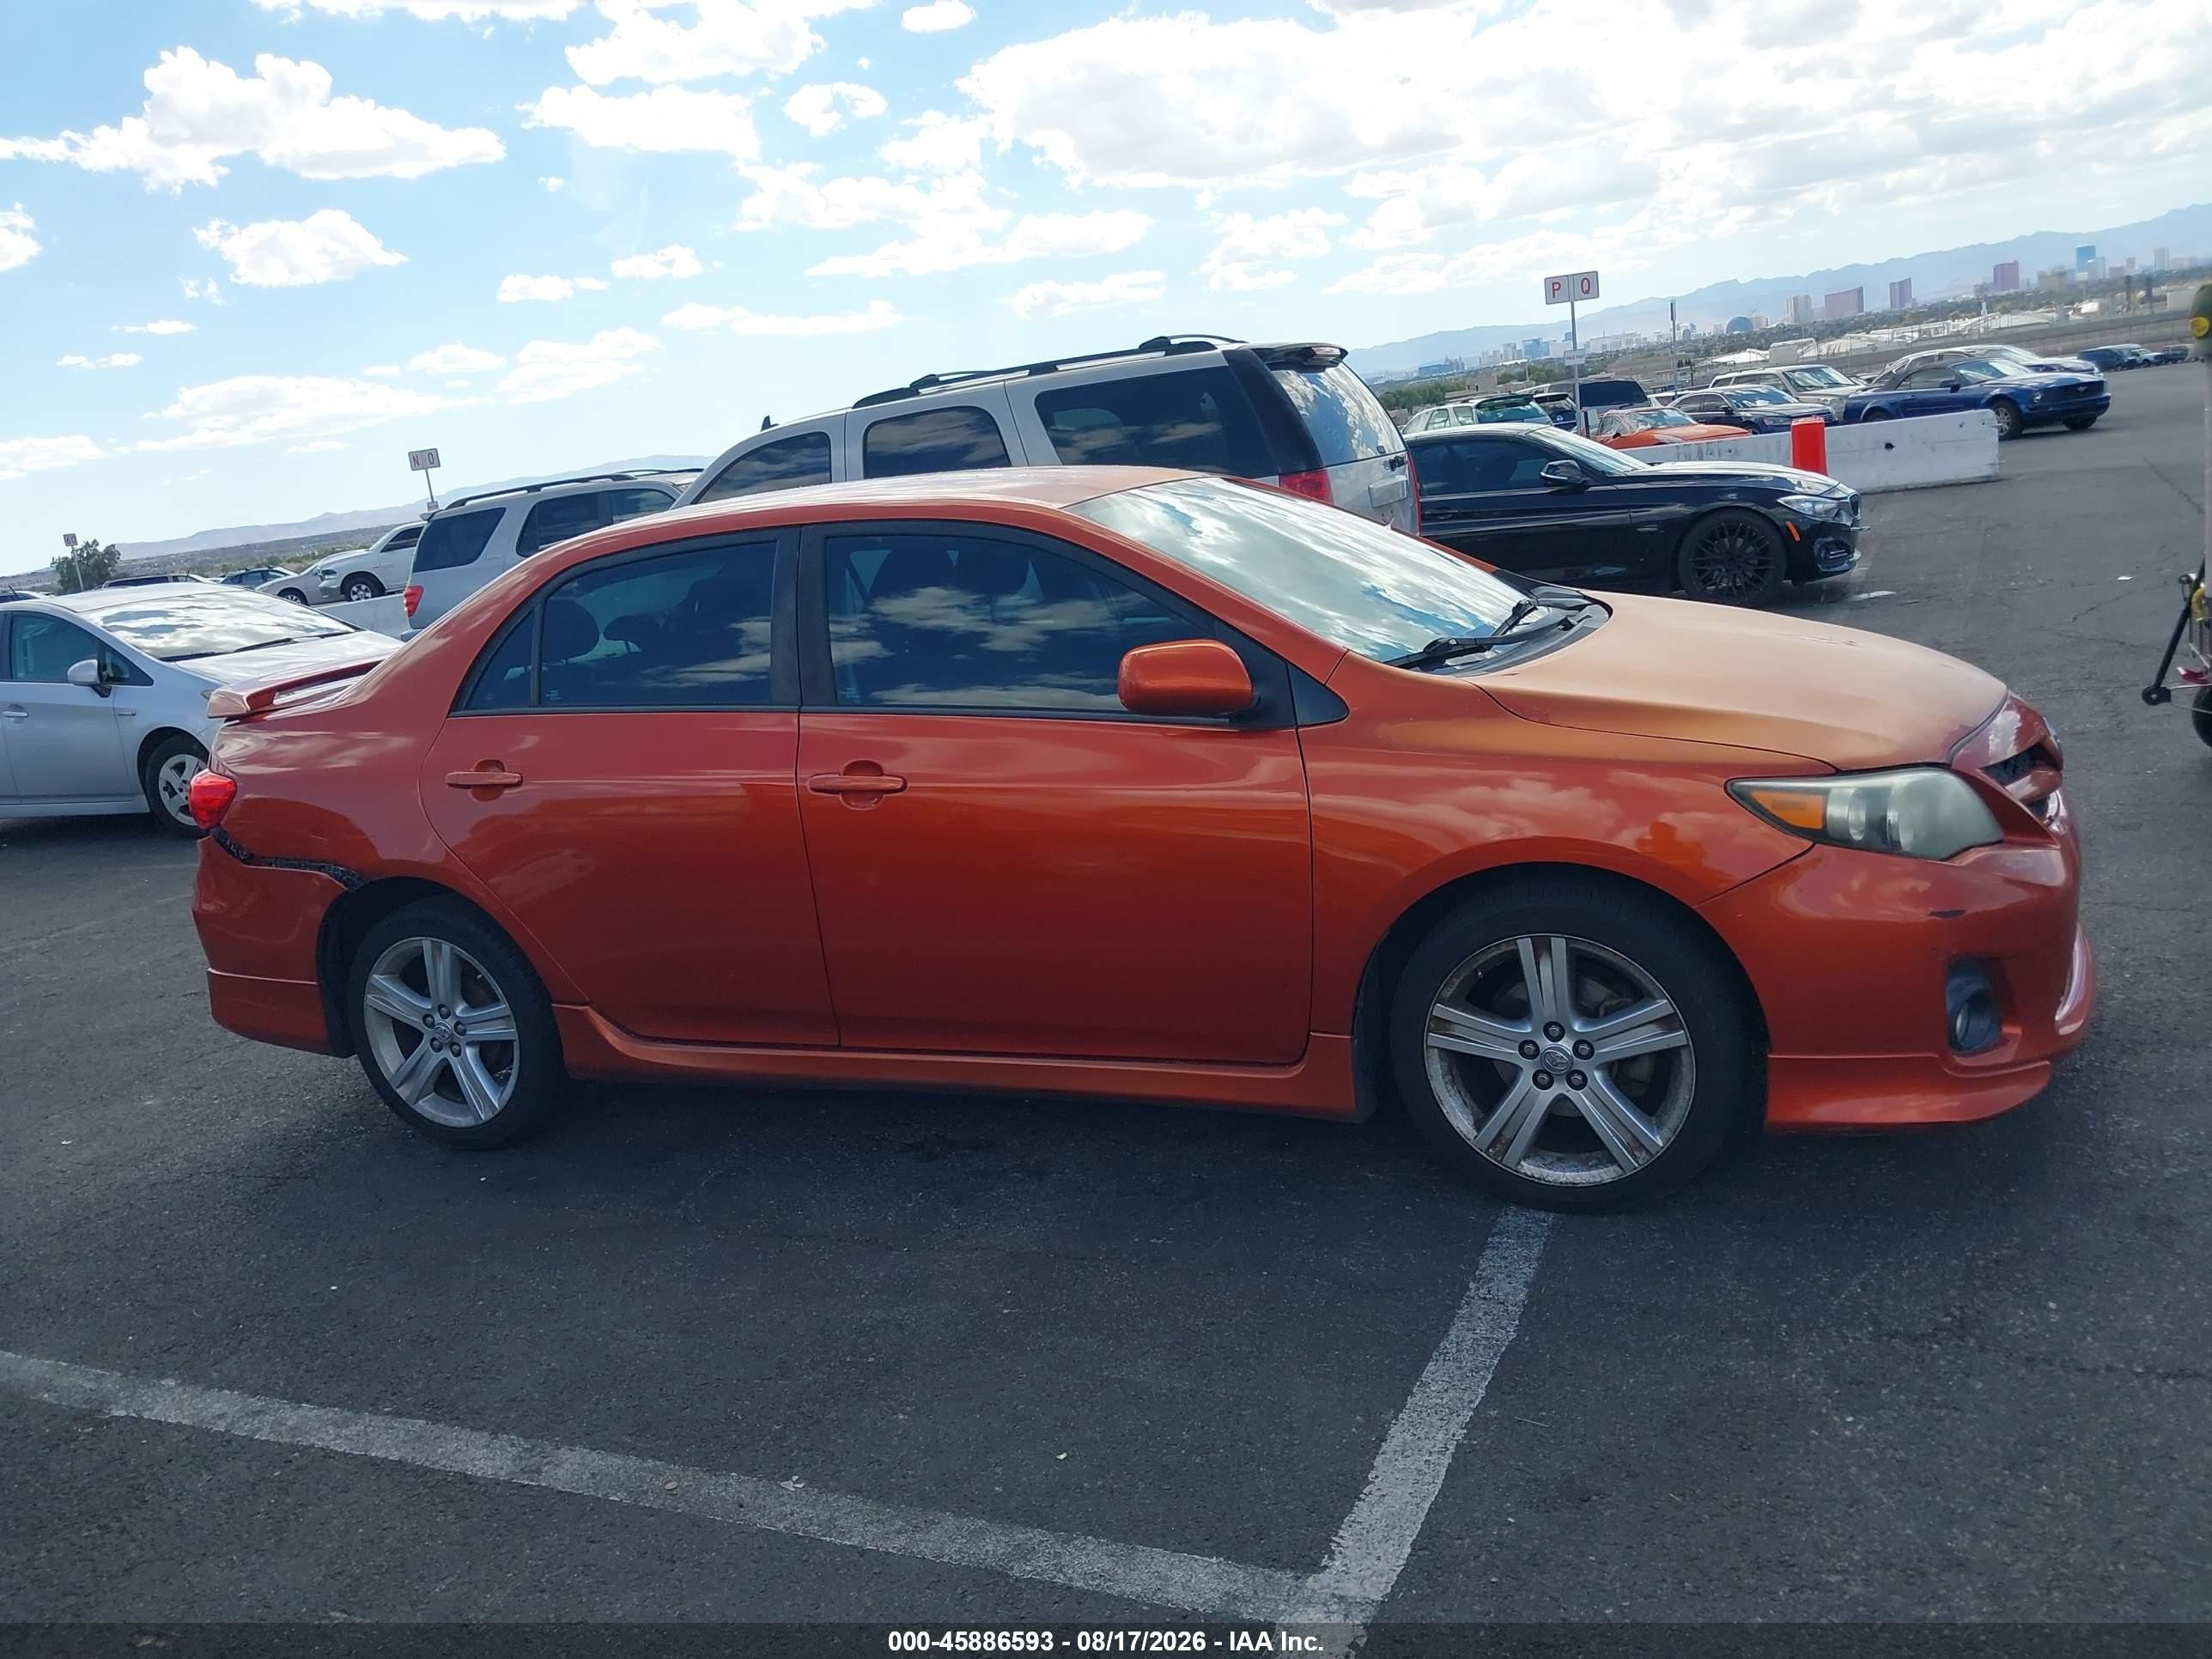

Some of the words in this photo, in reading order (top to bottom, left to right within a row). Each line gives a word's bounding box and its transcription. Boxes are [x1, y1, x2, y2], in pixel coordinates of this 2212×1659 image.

[1552, 281, 1561, 299] P
[1580, 276, 1591, 295] Q
[412, 454, 420, 467] N
